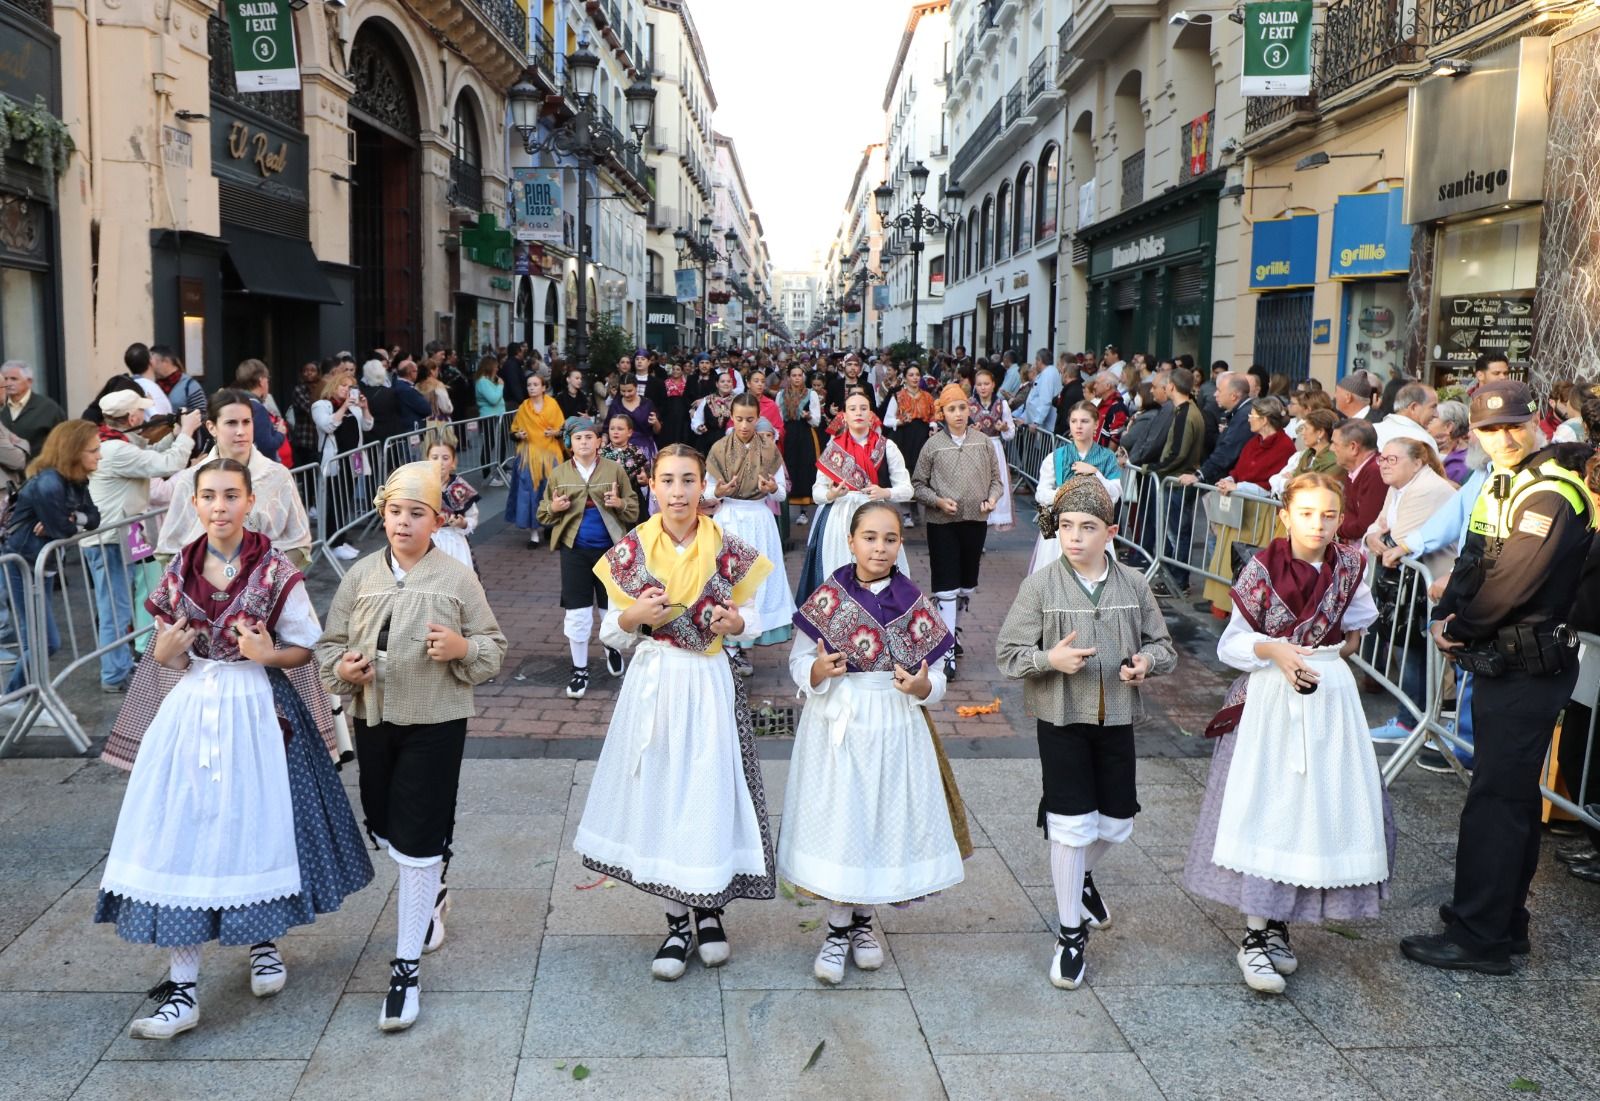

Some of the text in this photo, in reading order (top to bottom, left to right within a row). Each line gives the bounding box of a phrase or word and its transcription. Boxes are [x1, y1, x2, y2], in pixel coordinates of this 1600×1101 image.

[239, 2, 278, 16] SALIDA
[252, 18, 277, 31] EXIT
[1259, 11, 1298, 25] SALIDA
[1269, 26, 1295, 39] EXIT
[260, 43, 270, 56] 3
[1272, 50, 1281, 63] 3
[229, 121, 249, 159] El
[252, 132, 287, 177] Real
[1438, 169, 1508, 201] santiago
[525, 184, 552, 215] PILAR
[530, 206, 552, 216] 2022
[1450, 316, 1480, 327] CHOCOLATE
